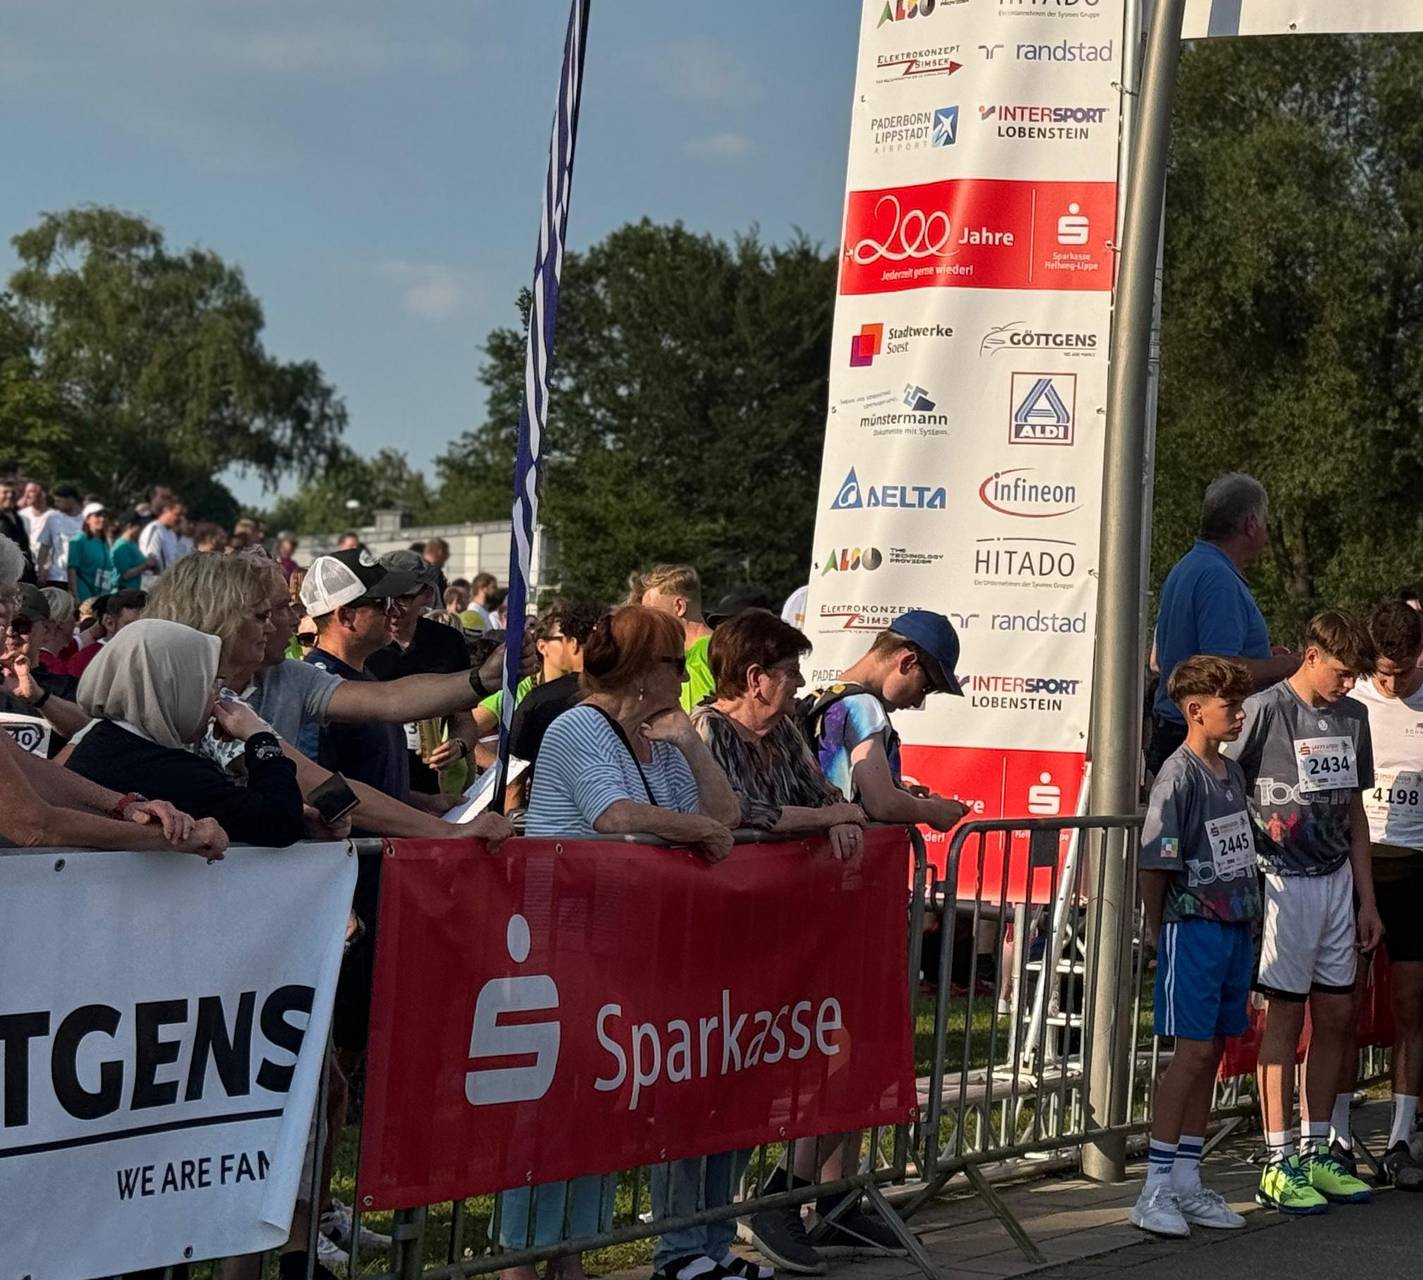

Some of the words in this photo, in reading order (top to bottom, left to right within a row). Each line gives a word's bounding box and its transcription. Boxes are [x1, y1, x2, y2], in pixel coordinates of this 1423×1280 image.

[877, 45, 961, 64] ELEKTROKONZEPT
[1016, 39, 1113, 61] randstad
[871, 112, 931, 131] PADERBORN
[998, 106, 1106, 123] INTERSPORT
[874, 127, 930, 145] LIPPSTADT
[998, 126, 1089, 140] LOBENSTEIN
[958, 228, 1014, 246] Jahre
[889, 324, 953, 340] Stadtwerke
[1010, 329, 1097, 347] GÖTTGENS
[886, 342, 910, 355] Soest
[860, 413, 948, 428] münstermann
[1019, 425, 1065, 439] ALDI
[867, 485, 946, 510] DELTA
[975, 550, 1075, 577] HITADO
[991, 610, 1087, 634] randstad
[973, 675, 1079, 695] INTERSPORT
[971, 696, 1062, 711] LOBENSTEIN
[1308, 756, 1350, 775] 2434
[1372, 787, 1419, 805] 4198
[1219, 832, 1249, 856] 2445
[594, 990, 842, 1110] Sparkasse
[117, 1165, 155, 1200] WE
[161, 1156, 212, 1194] ARE
